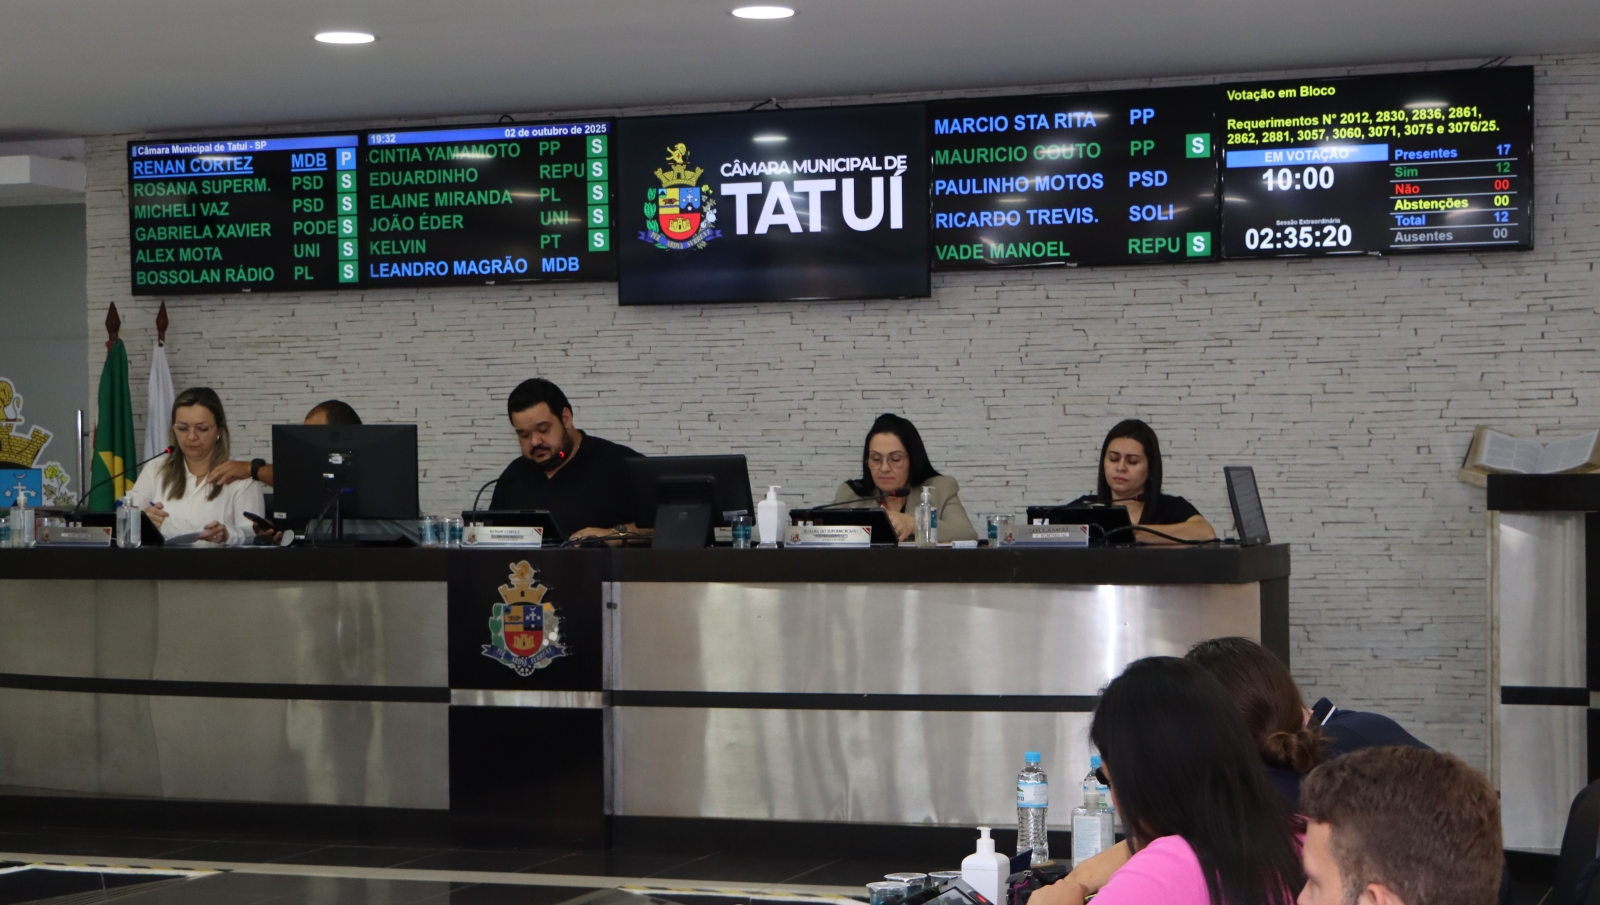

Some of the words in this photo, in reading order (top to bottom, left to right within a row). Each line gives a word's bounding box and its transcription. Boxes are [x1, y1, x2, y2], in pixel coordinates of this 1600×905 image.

[1227, 88, 1275, 101] Votação
[1278, 87, 1296, 98] em
[1300, 86, 1336, 97] Bloco
[934, 116, 1008, 134] MARCIO
[1014, 114, 1049, 131] STA
[1054, 112, 1096, 129] RITA
[1130, 109, 1154, 125] PP
[1227, 114, 1319, 130] Requerimentos
[1340, 113, 1372, 126] 2012,
[1376, 110, 1408, 123] 2830,
[1412, 108, 1444, 121] 2836,
[1448, 106, 1481, 119] 2861,
[371, 134, 396, 143] 19:32
[505, 129, 516, 138] 02
[518, 128, 529, 137] de
[531, 126, 568, 136] outubro
[571, 126, 582, 135] de
[584, 124, 606, 134] 2025
[1227, 132, 1258, 146] 2862,
[1262, 130, 1294, 144] 2881,
[1297, 129, 1329, 142] 3057,
[1332, 127, 1364, 140] 3060,
[1368, 125, 1400, 138] 3071,
[1404, 124, 1433, 135] 3075
[1437, 124, 1444, 133] e
[1448, 120, 1499, 133] 3076/25.
[138, 146, 170, 155] Câmara
[172, 144, 212, 155] Municipal
[214, 143, 224, 151] de
[227, 142, 247, 151] Tatuí
[255, 141, 267, 150] SP
[368, 148, 422, 163] CINTIA
[425, 143, 520, 160] YAMAMOTO
[539, 142, 560, 156] PP
[592, 139, 602, 153] S
[935, 146, 1027, 165] MAURICIO
[1033, 142, 1101, 160] COUTO
[1130, 140, 1155, 156] PP
[1192, 137, 1204, 153] S
[1265, 152, 1284, 162] EM
[1395, 147, 1458, 161] Presentes
[1497, 144, 1511, 155] 17
[133, 159, 185, 174] RENAN
[190, 156, 253, 172] CORTEZ
[291, 153, 327, 168] MDB
[342, 152, 351, 166] P
[369, 168, 478, 186] EDUARDINHO
[540, 163, 584, 179] REPU
[592, 162, 602, 177] S
[720, 160, 791, 177] CÂMARA
[793, 156, 882, 174] MUNICIPAL
[884, 155, 907, 170] DE
[1395, 166, 1418, 177] Sim
[1496, 162, 1510, 172] 12
[134, 181, 198, 196] ROSANA
[201, 178, 271, 194] SUPERM.
[292, 176, 323, 190] PSD
[342, 174, 352, 188] S
[935, 176, 1030, 195] PAULINHO
[1035, 173, 1104, 191] MOTOS
[1129, 171, 1168, 187] PSD
[1262, 166, 1335, 191] 10:00
[1395, 183, 1420, 194] Não
[1494, 179, 1509, 190] 00
[135, 204, 196, 219] MICHELI
[200, 202, 229, 216] VAZ
[293, 199, 324, 212] PSD
[342, 197, 352, 210] S
[370, 193, 429, 209] ELAINE
[435, 189, 512, 206] MIRANDA
[540, 188, 560, 202] PL
[592, 186, 603, 200] S
[720, 168, 908, 235] TATUÍ
[1394, 197, 1468, 211] Abstenções
[1494, 195, 1509, 207] 00
[370, 214, 414, 232] JOÃO
[420, 213, 464, 230] ÉDER
[540, 211, 568, 226] UNI
[593, 209, 603, 223] S
[936, 210, 1020, 228] RICARDO
[1027, 207, 1098, 225] TREVIS.
[1129, 204, 1174, 222] SOLI
[1395, 214, 1426, 226] Total
[1494, 212, 1509, 222] 12
[135, 225, 213, 241] GABRIELA
[216, 223, 271, 238] XAVIER
[293, 220, 337, 235] PODE
[343, 220, 352, 233] S
[1245, 225, 1352, 249] 02:35:20
[1395, 230, 1453, 242] Ausentes
[1493, 228, 1508, 238] 00
[136, 249, 174, 263] ALEX
[179, 248, 222, 262] MOTA
[294, 244, 320, 258] UNI
[343, 242, 353, 256] S
[370, 239, 426, 255] KELVIN
[541, 235, 561, 249] PT
[593, 233, 604, 247] S
[936, 244, 984, 260] VADE
[990, 242, 1070, 258] MANOEL
[1128, 237, 1180, 254] REPU
[1192, 236, 1205, 252] S
[136, 269, 220, 285] BOSSOLAN
[226, 265, 274, 282] RÁDIO
[294, 266, 313, 280] PL
[344, 264, 353, 278] S
[370, 261, 448, 278] LEANDRO
[454, 256, 527, 275] MAGRÃO
[542, 257, 579, 272] MDB
